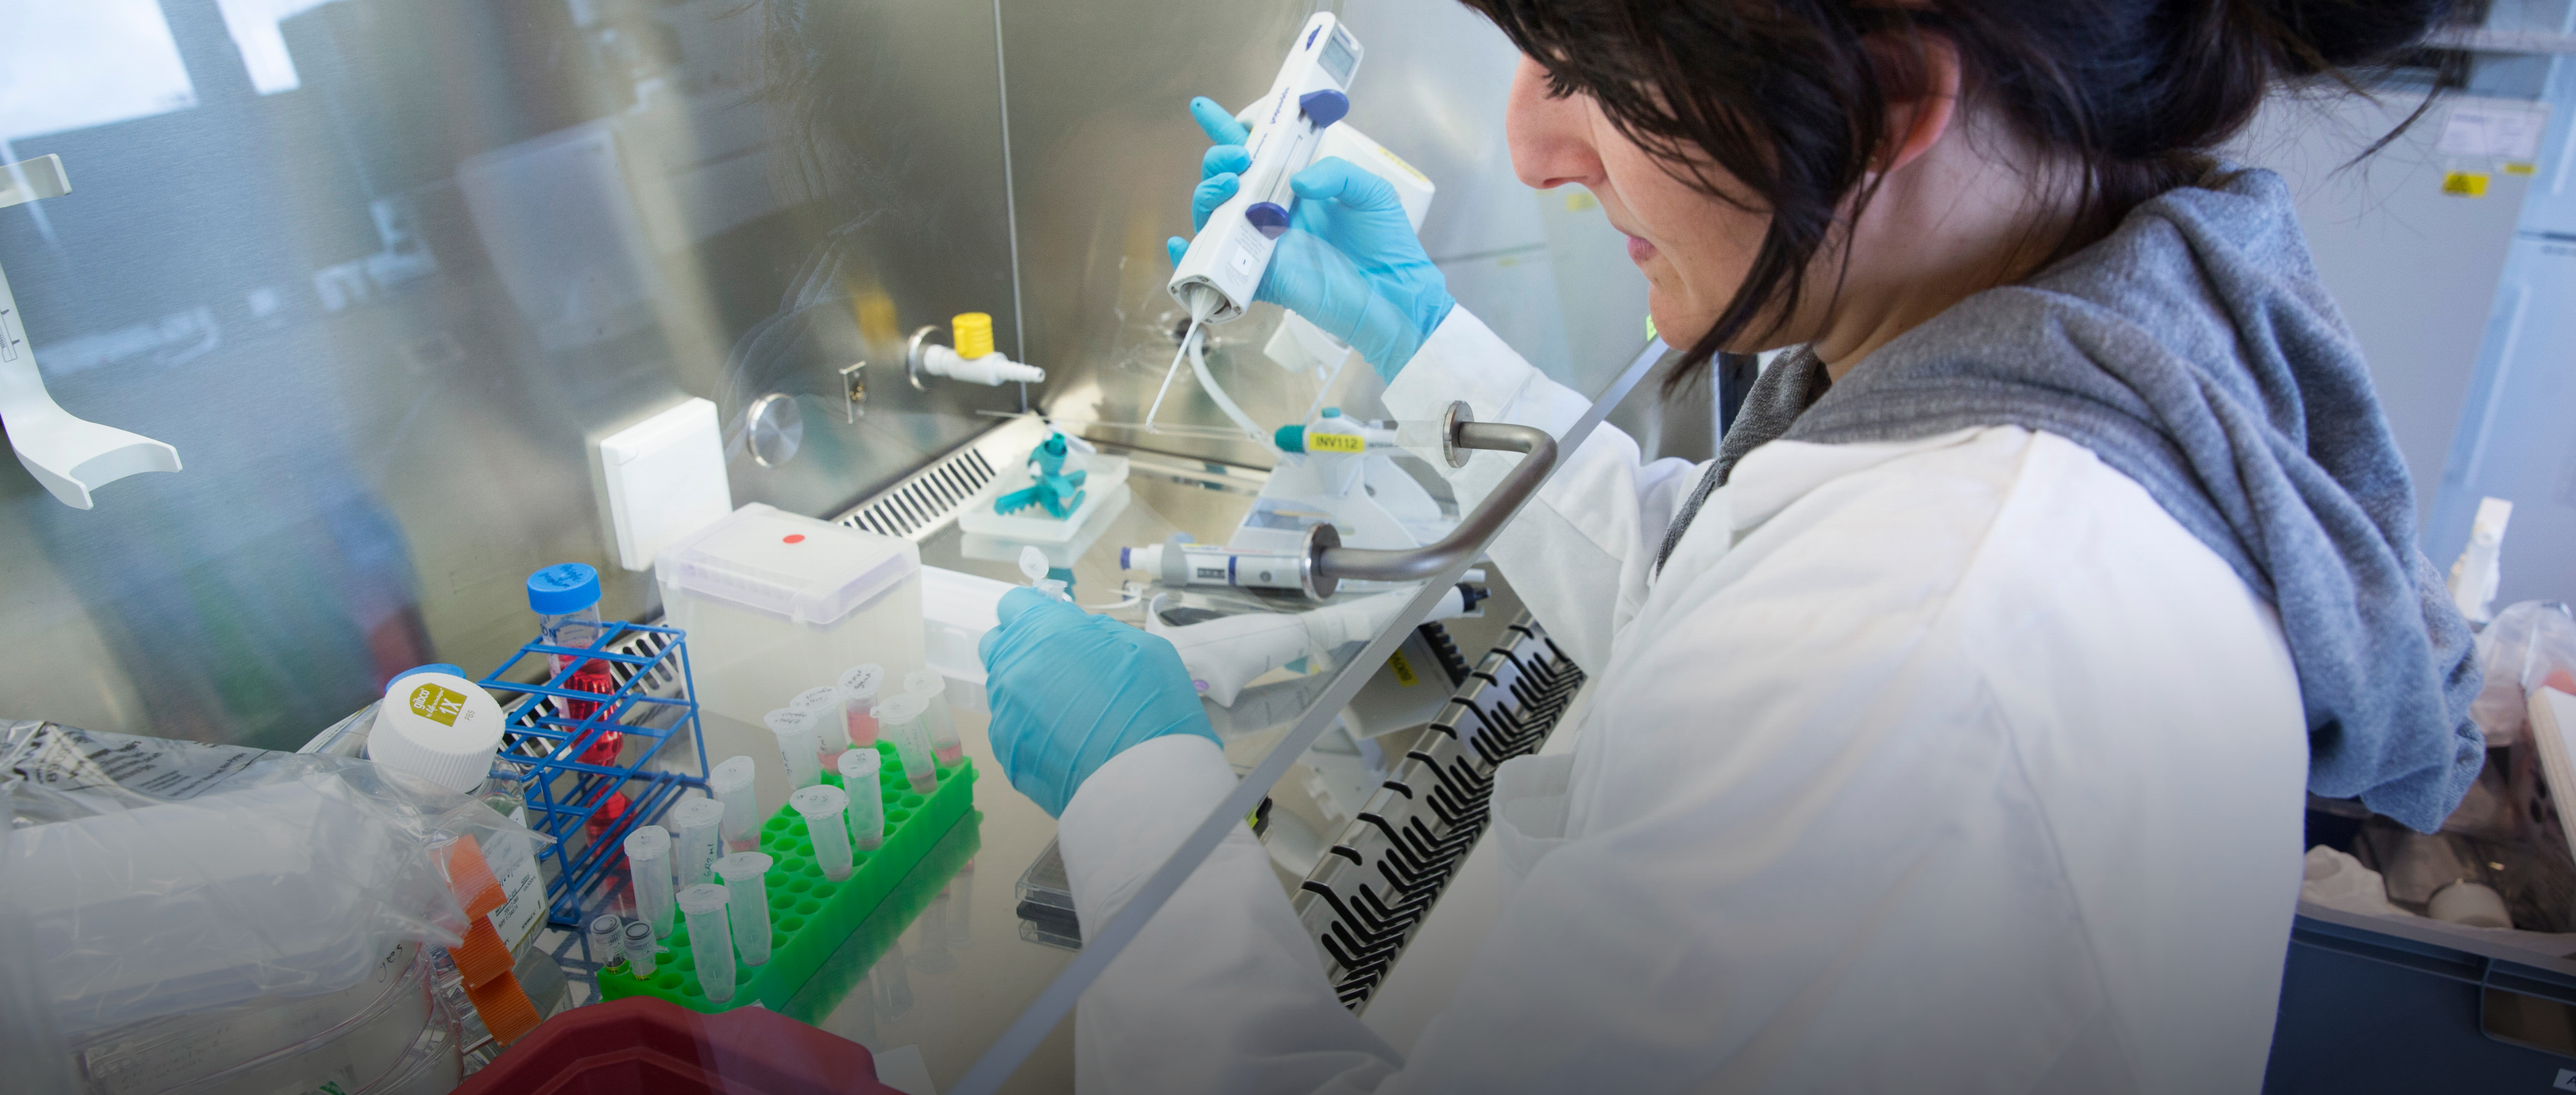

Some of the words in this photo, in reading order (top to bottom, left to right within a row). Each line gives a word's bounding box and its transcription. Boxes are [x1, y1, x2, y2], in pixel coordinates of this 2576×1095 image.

[1316, 437, 1357, 449] INV112
[413, 689, 430, 709] gibco
[439, 698, 462, 715] 1X
[464, 710, 475, 721] PBS
